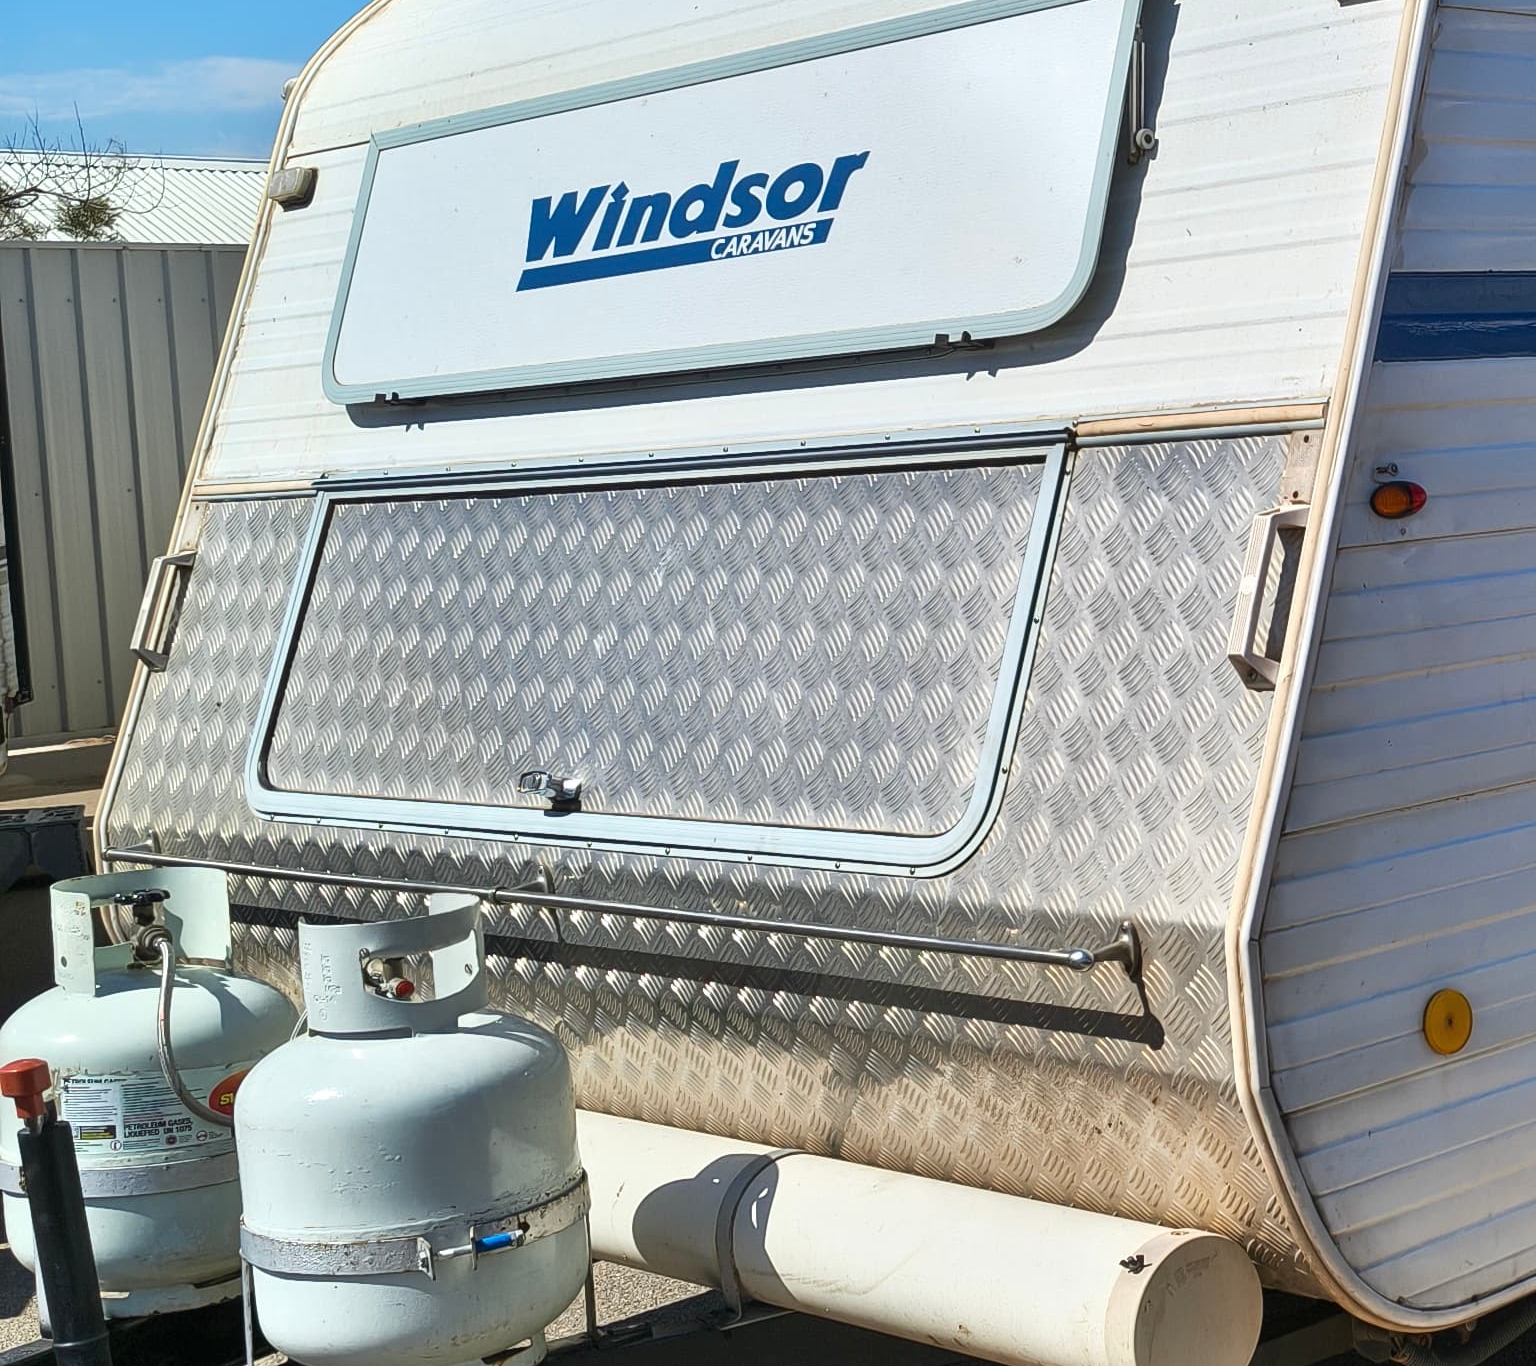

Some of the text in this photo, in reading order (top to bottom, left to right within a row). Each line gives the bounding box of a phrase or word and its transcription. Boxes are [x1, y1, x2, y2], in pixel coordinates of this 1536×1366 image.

[525, 150, 871, 263] Windsor
[710, 222, 817, 260] CARAVANS
[123, 1120, 167, 1131] PETROLEUM
[123, 1128, 160, 1139] LIQUEFIED
[176, 1125, 193, 1134] 1075
